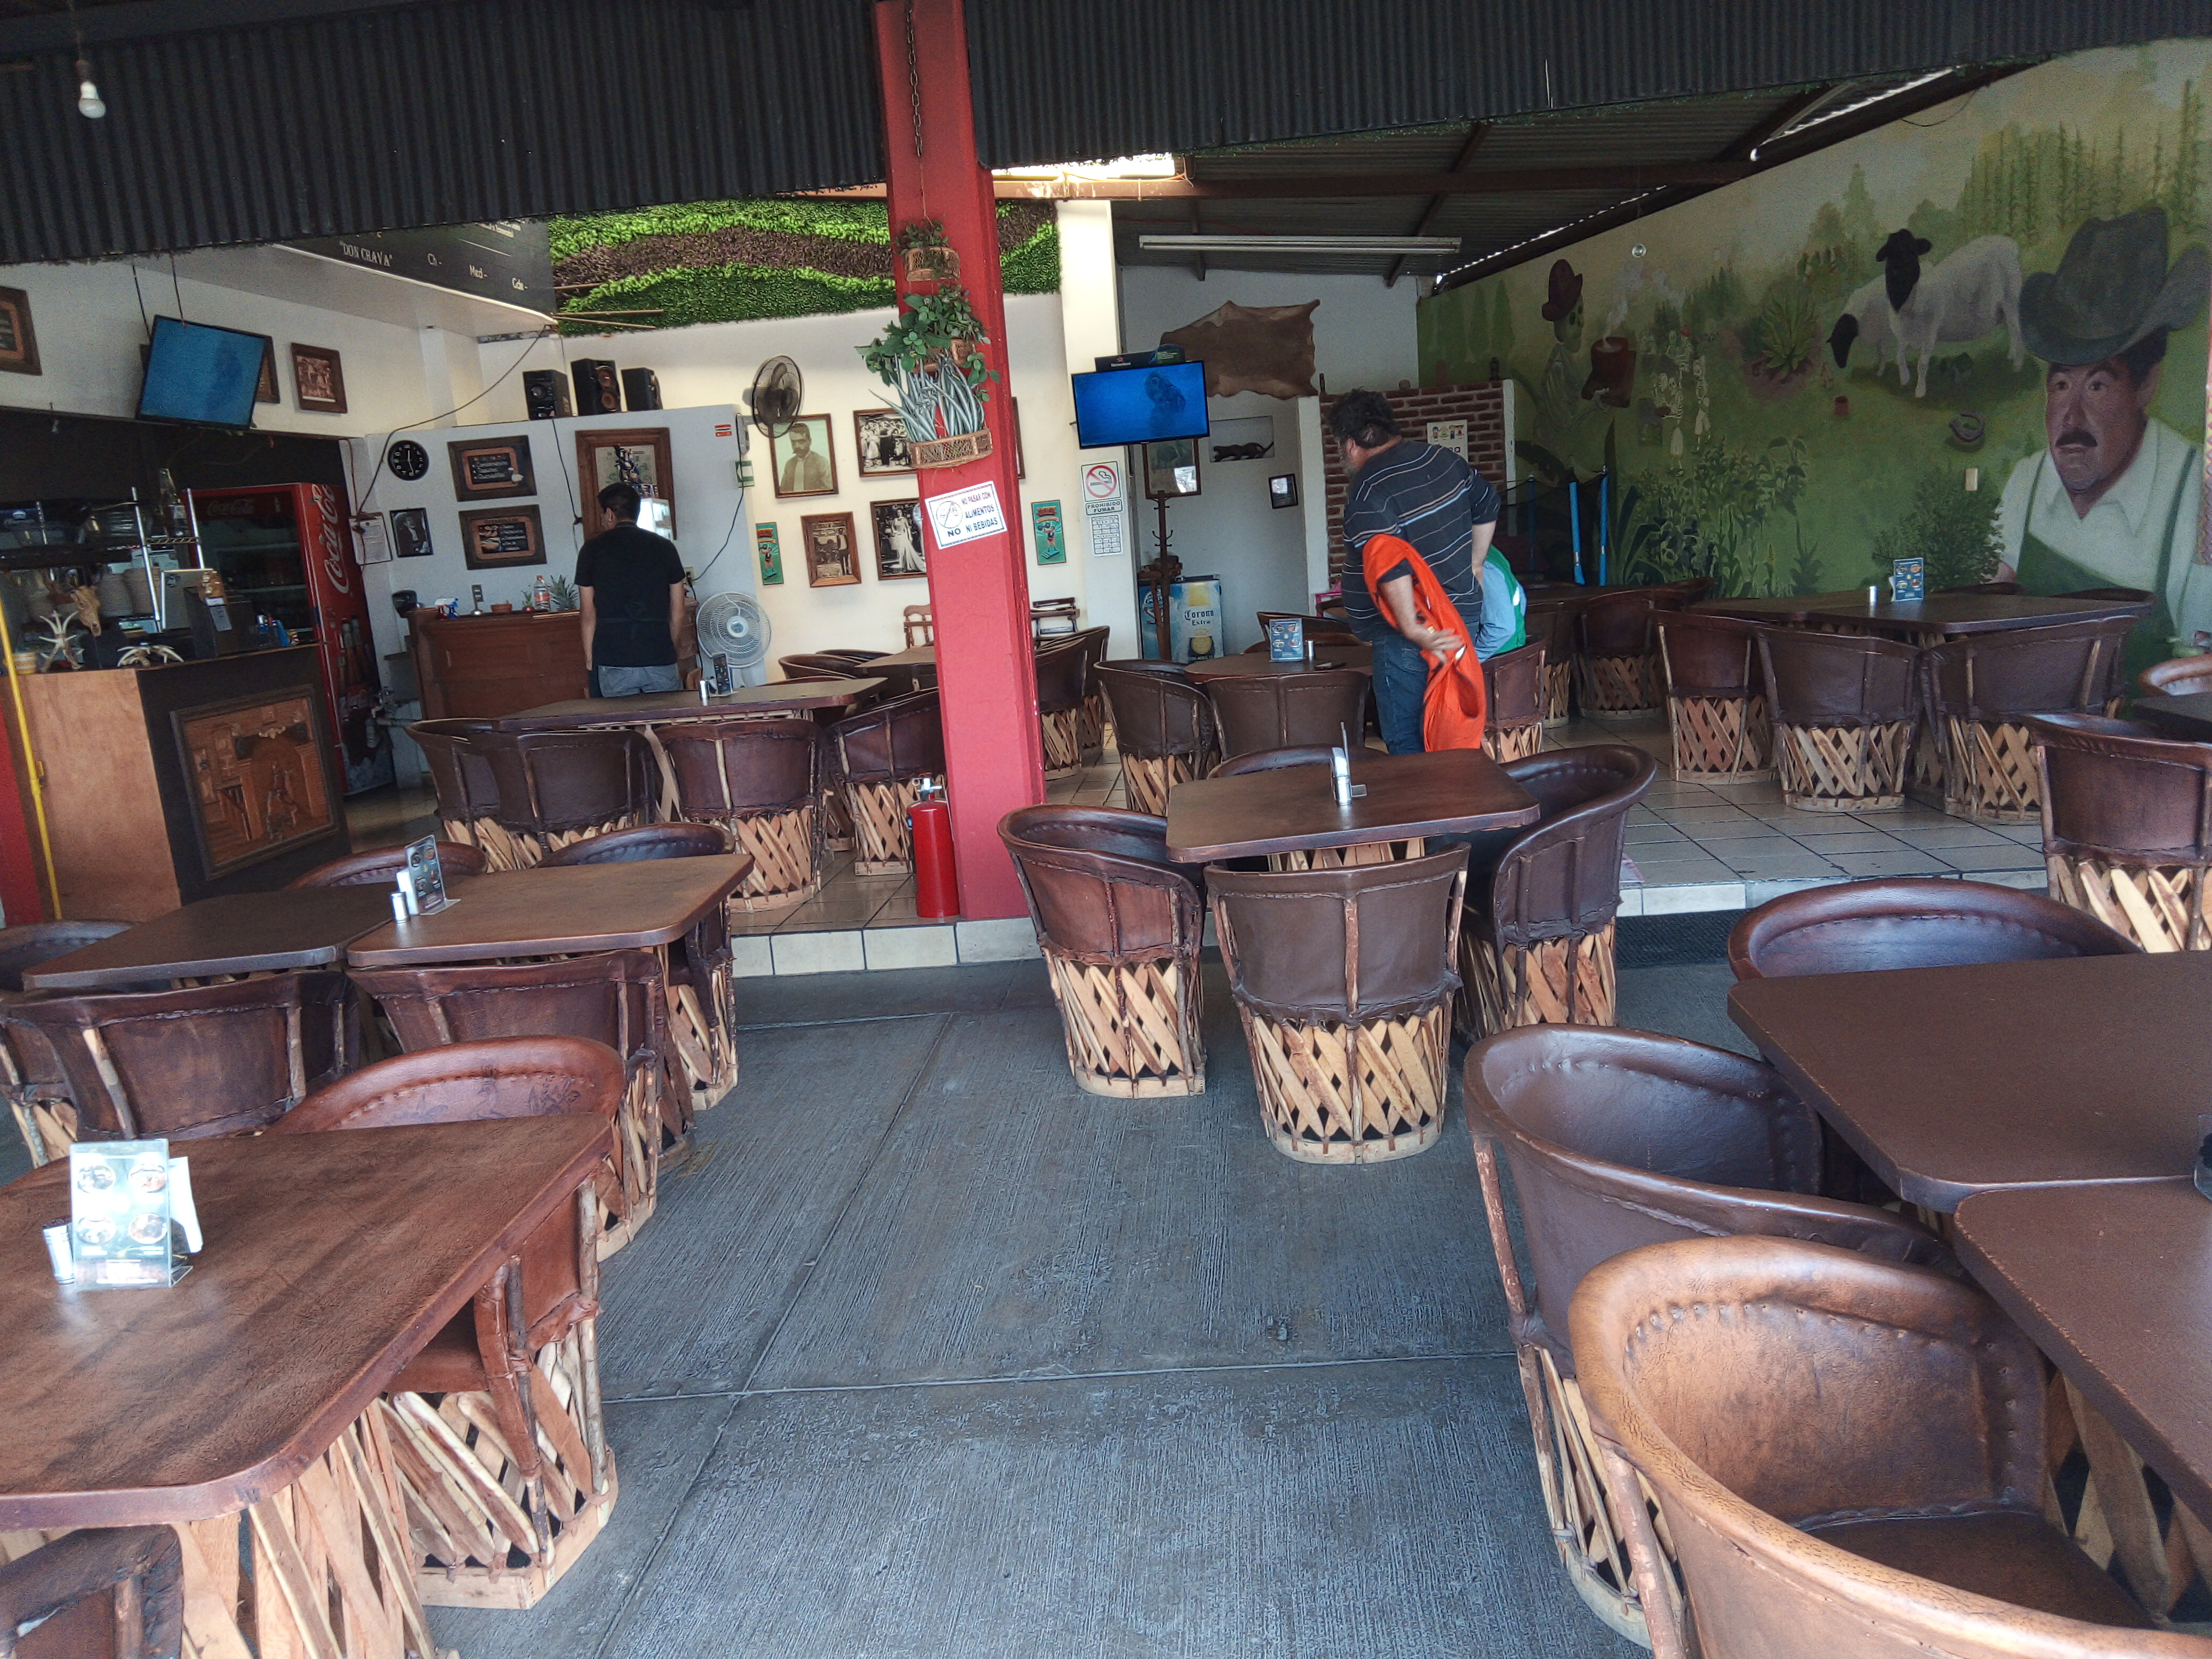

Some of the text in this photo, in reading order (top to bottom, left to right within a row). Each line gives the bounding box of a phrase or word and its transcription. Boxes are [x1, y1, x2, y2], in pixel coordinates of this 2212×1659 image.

[967, 494, 981, 504] PASAR
[1087, 501, 1120, 509] PROHIBIDO
[965, 505, 994, 519] ALIMENTOS
[966, 517, 998, 533] NI BEBIDAS
[947, 528, 961, 537] NO
[1184, 610, 1214, 621] Corona
